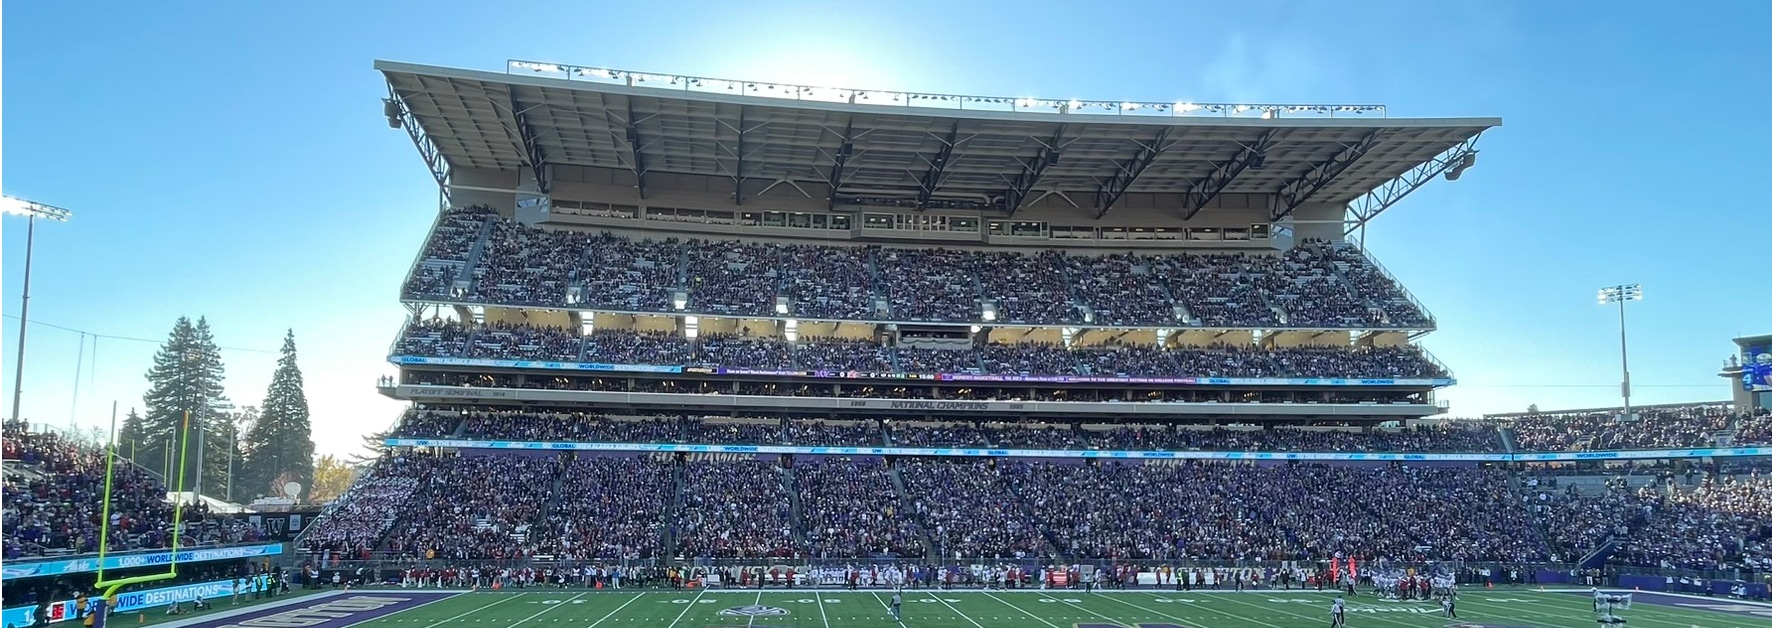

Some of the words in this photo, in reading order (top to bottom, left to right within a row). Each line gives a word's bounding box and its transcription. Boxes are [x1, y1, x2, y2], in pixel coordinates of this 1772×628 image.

[891, 400, 934, 409] NATIONAL
[936, 401, 988, 410] CHAMPIONS
[193, 547, 245, 560] DESTINATIONS
[145, 583, 219, 604] DESTINATIONS
